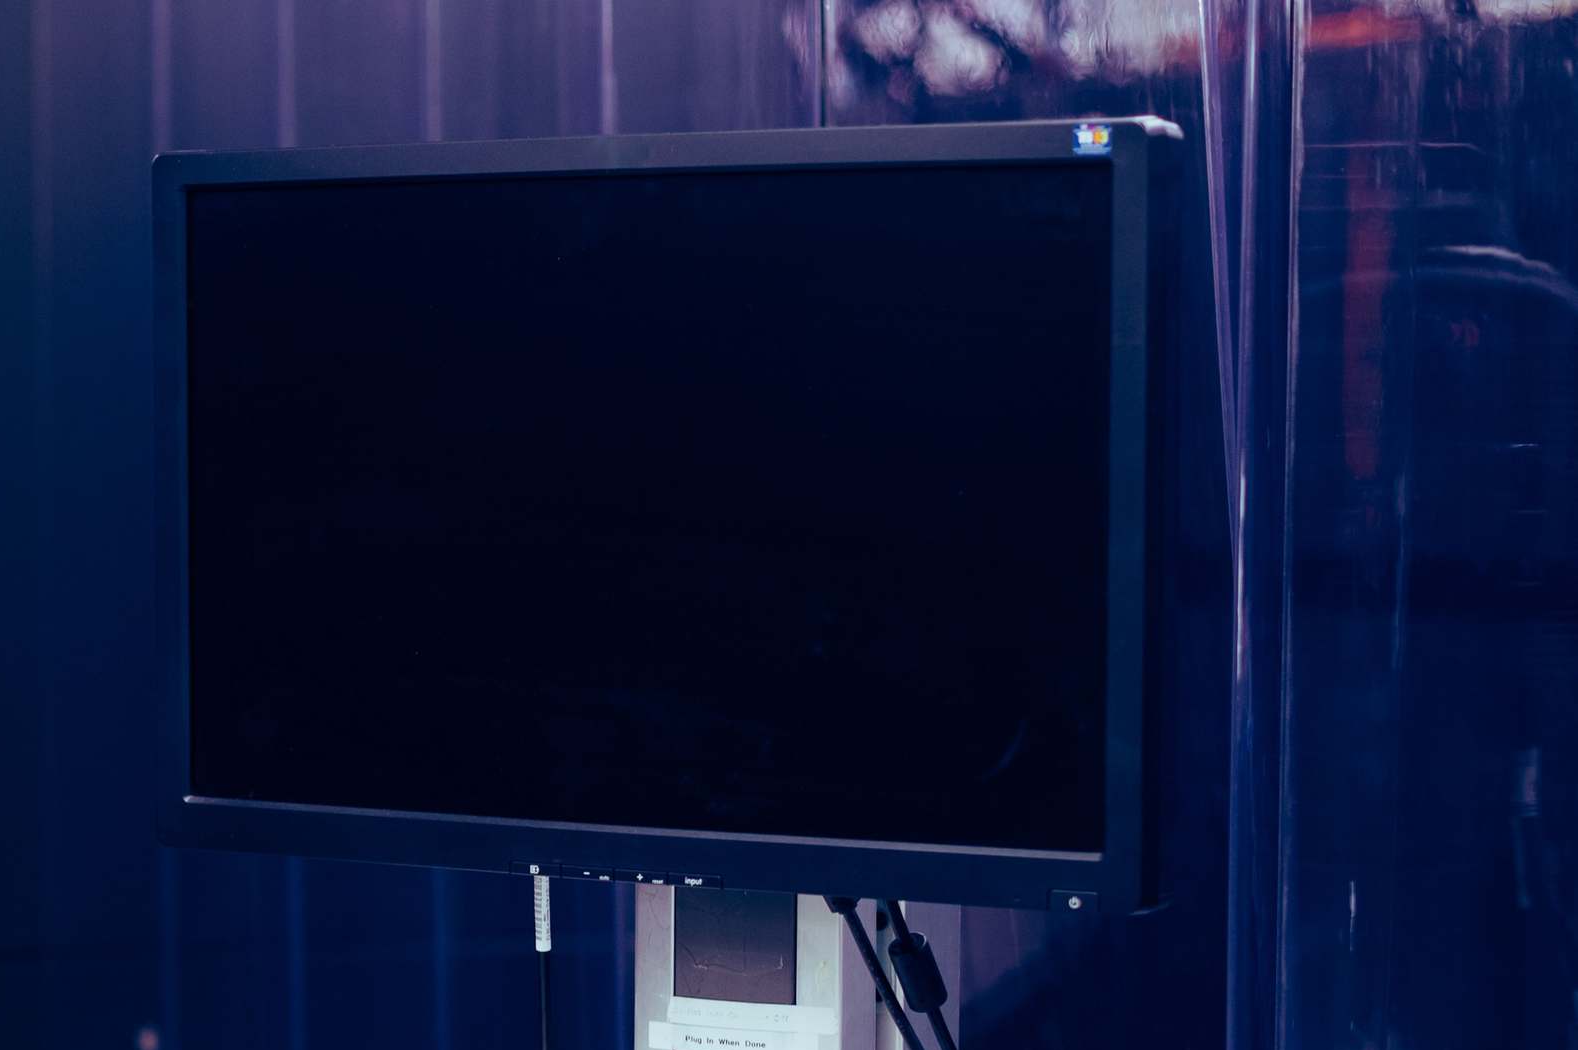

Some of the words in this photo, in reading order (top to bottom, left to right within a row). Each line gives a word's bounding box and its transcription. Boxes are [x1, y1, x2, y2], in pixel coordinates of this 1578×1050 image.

[684, 876, 703, 886] input
[685, 1035, 702, 1045] Plug
[719, 1038, 740, 1046] When
[745, 1040, 766, 1048] Done
